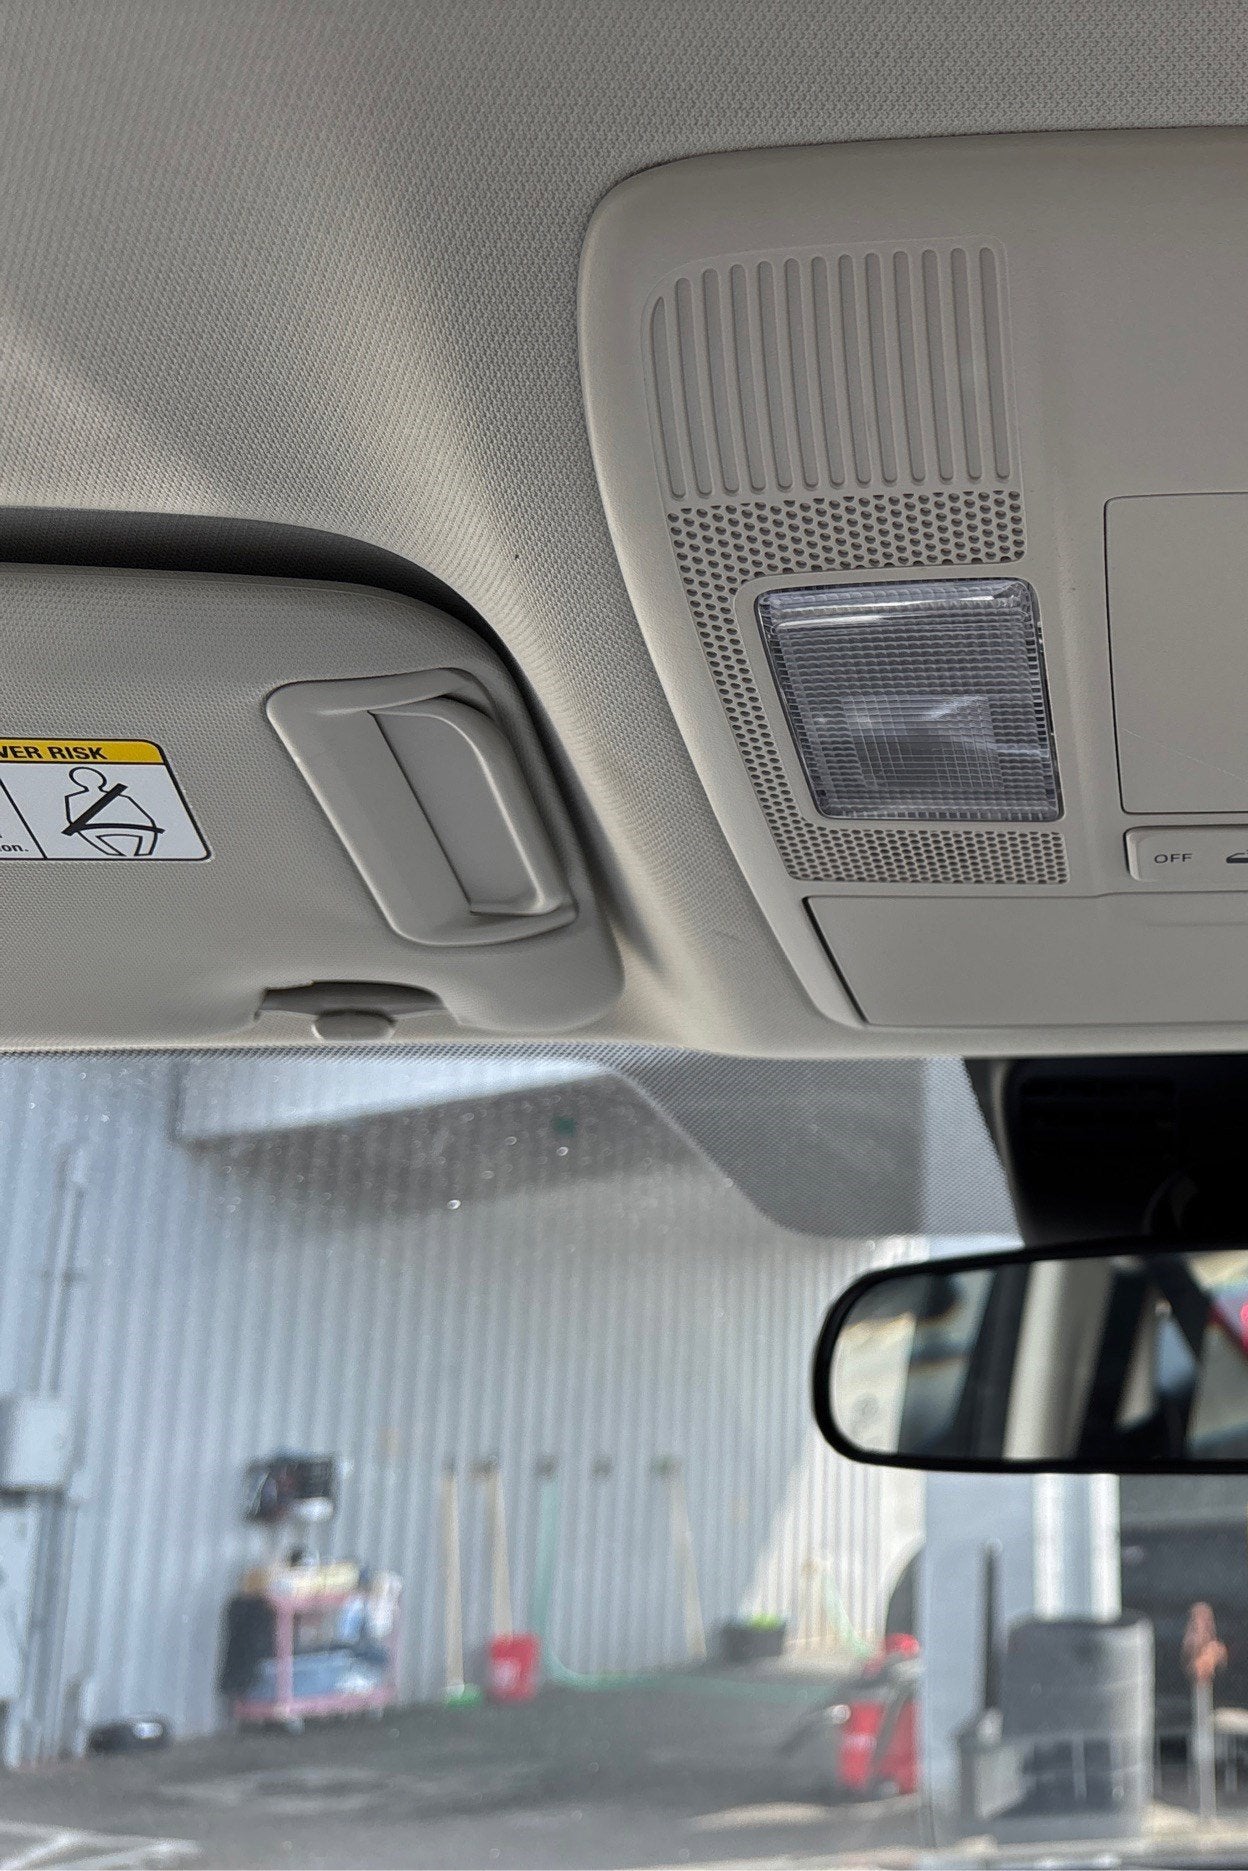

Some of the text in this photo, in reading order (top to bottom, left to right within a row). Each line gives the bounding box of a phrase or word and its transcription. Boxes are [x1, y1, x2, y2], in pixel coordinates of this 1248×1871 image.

[47, 746, 107, 759] RISK
[0, 844, 29, 852] on.
[1154, 852, 1192, 864] OFF
